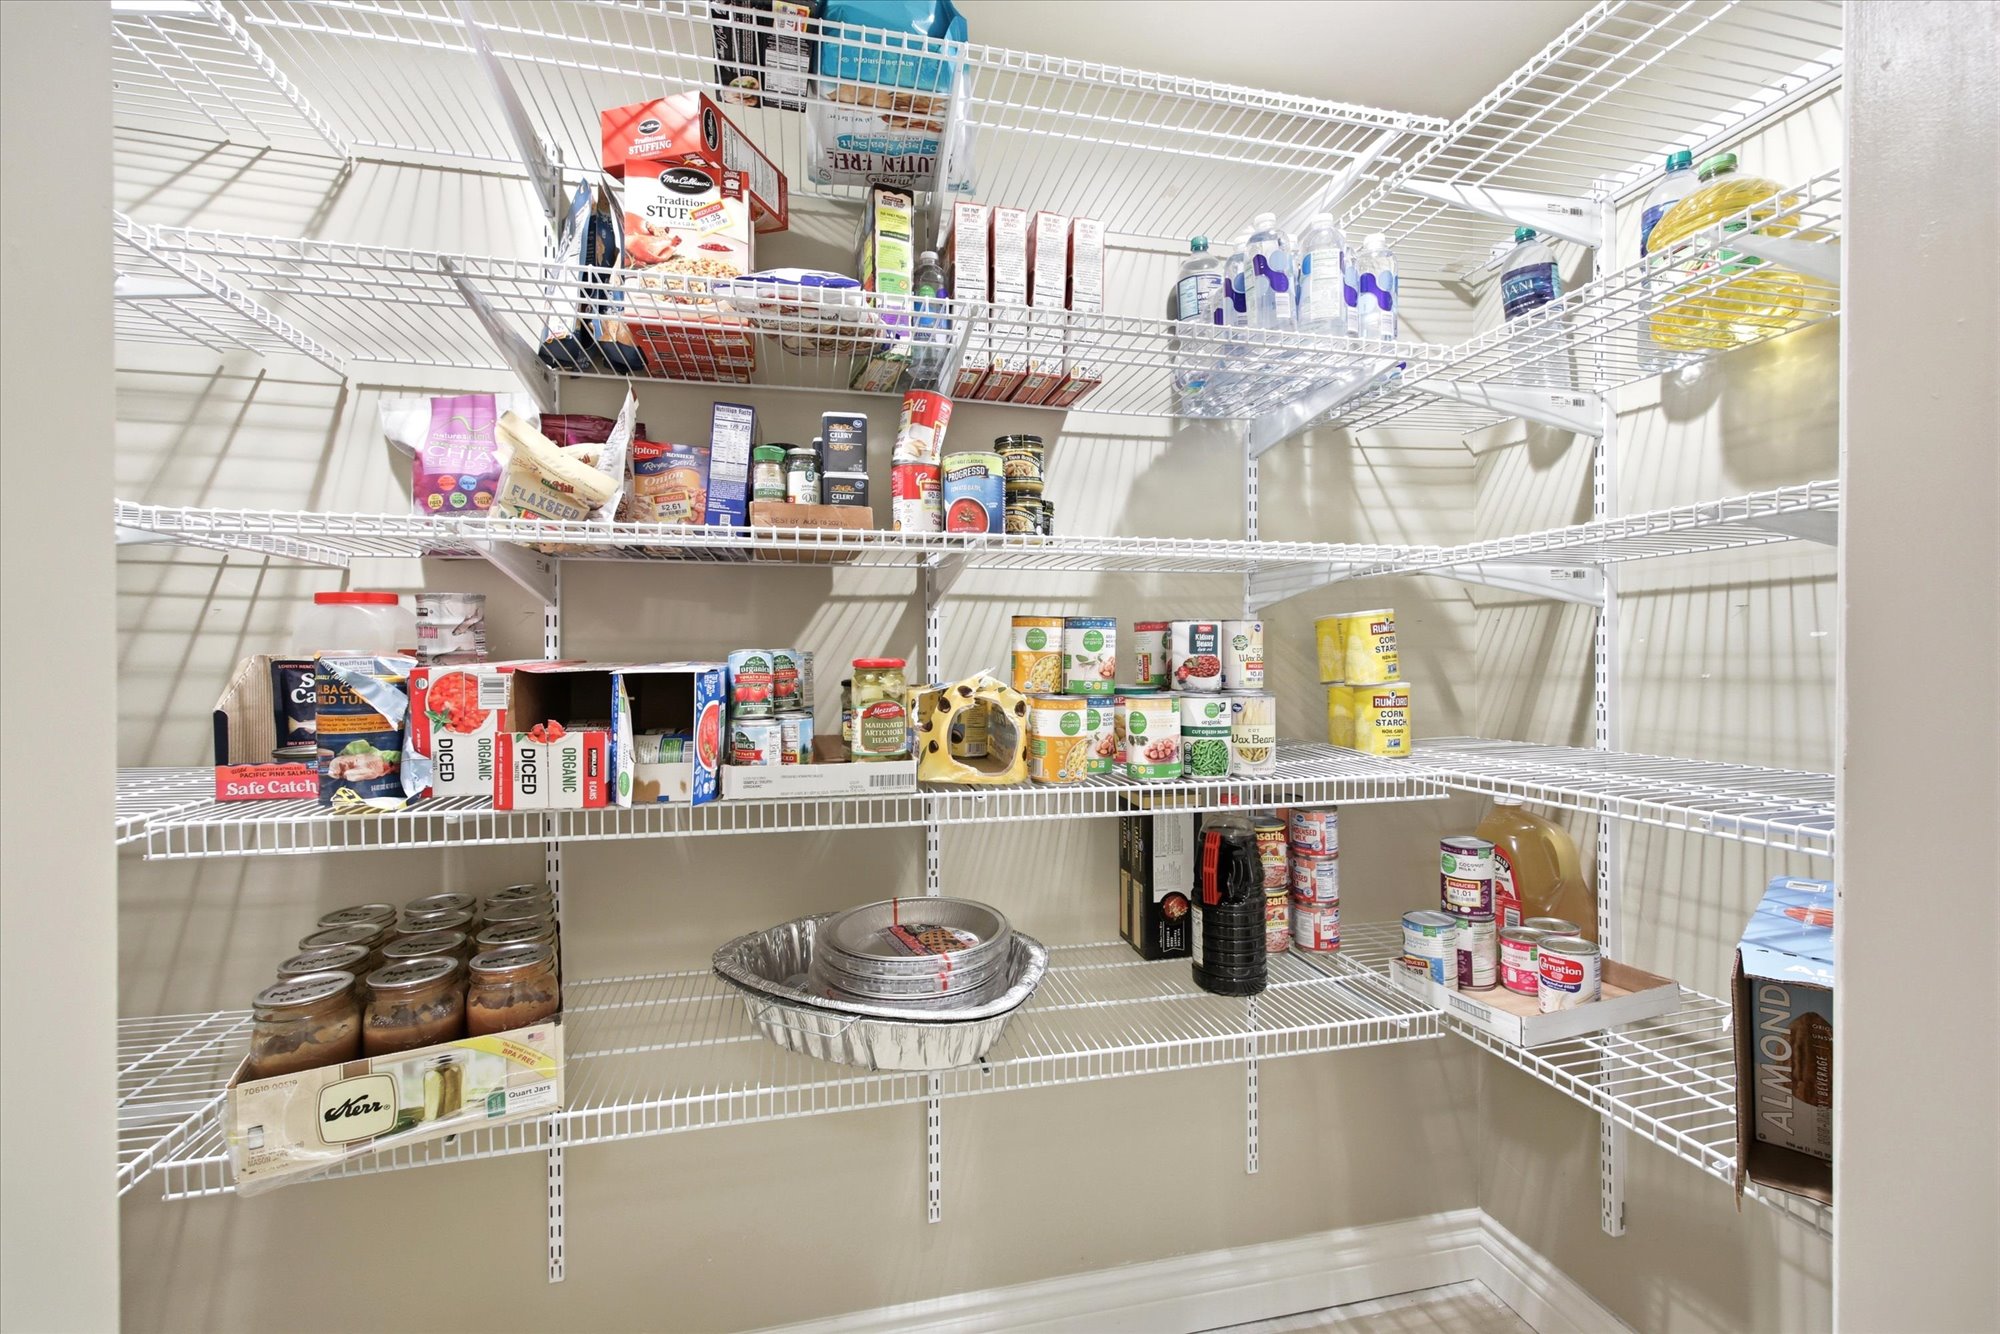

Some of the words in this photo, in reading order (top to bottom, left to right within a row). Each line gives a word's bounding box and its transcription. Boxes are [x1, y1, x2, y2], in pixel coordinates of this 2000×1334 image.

[628, 140, 672, 155] STUFFING
[657, 195, 709, 208] Tradition
[647, 205, 692, 220] STUF
[1502, 279, 1533, 298] SANI
[715, 406, 738, 414] Nutrition
[738, 408, 752, 416] Facts
[427, 446, 491, 462] CHIA
[634, 445, 660, 457] ipton
[426, 457, 488, 470] SEEDS
[644, 471, 685, 485] Onion
[947, 465, 986, 482] PROGRESSO
[511, 484, 580, 520] FLAXSEED
[661, 503, 682, 511] $2.61
[1374, 698, 1408, 707] RUMFORD
[1380, 710, 1404, 718] CORN
[864, 721, 904, 729] MARINATED
[1375, 719, 1408, 727] STARCH
[872, 736, 899, 744] HEARTS
[438, 738, 455, 782] DICED
[478, 738, 492, 781] ORGANIC
[239, 771, 267, 779] PACIFIC
[521, 748, 537, 795] DICED
[562, 747, 577, 793] ORGANIC
[225, 781, 265, 796] Safe
[268, 780, 319, 794] Catch
[1255, 831, 1285, 841] sarita
[1540, 957, 1582, 976] Carnation
[502, 1048, 517, 1058] BPA
[517, 1053, 536, 1066] FREE
[1759, 984, 1794, 1136] ALMOND
[1816, 1056, 1829, 1097] BEVERAGE
[508, 1088, 533, 1099] Quart
[534, 1085, 551, 1093] Jars
[324, 1094, 383, 1122] Kerr
